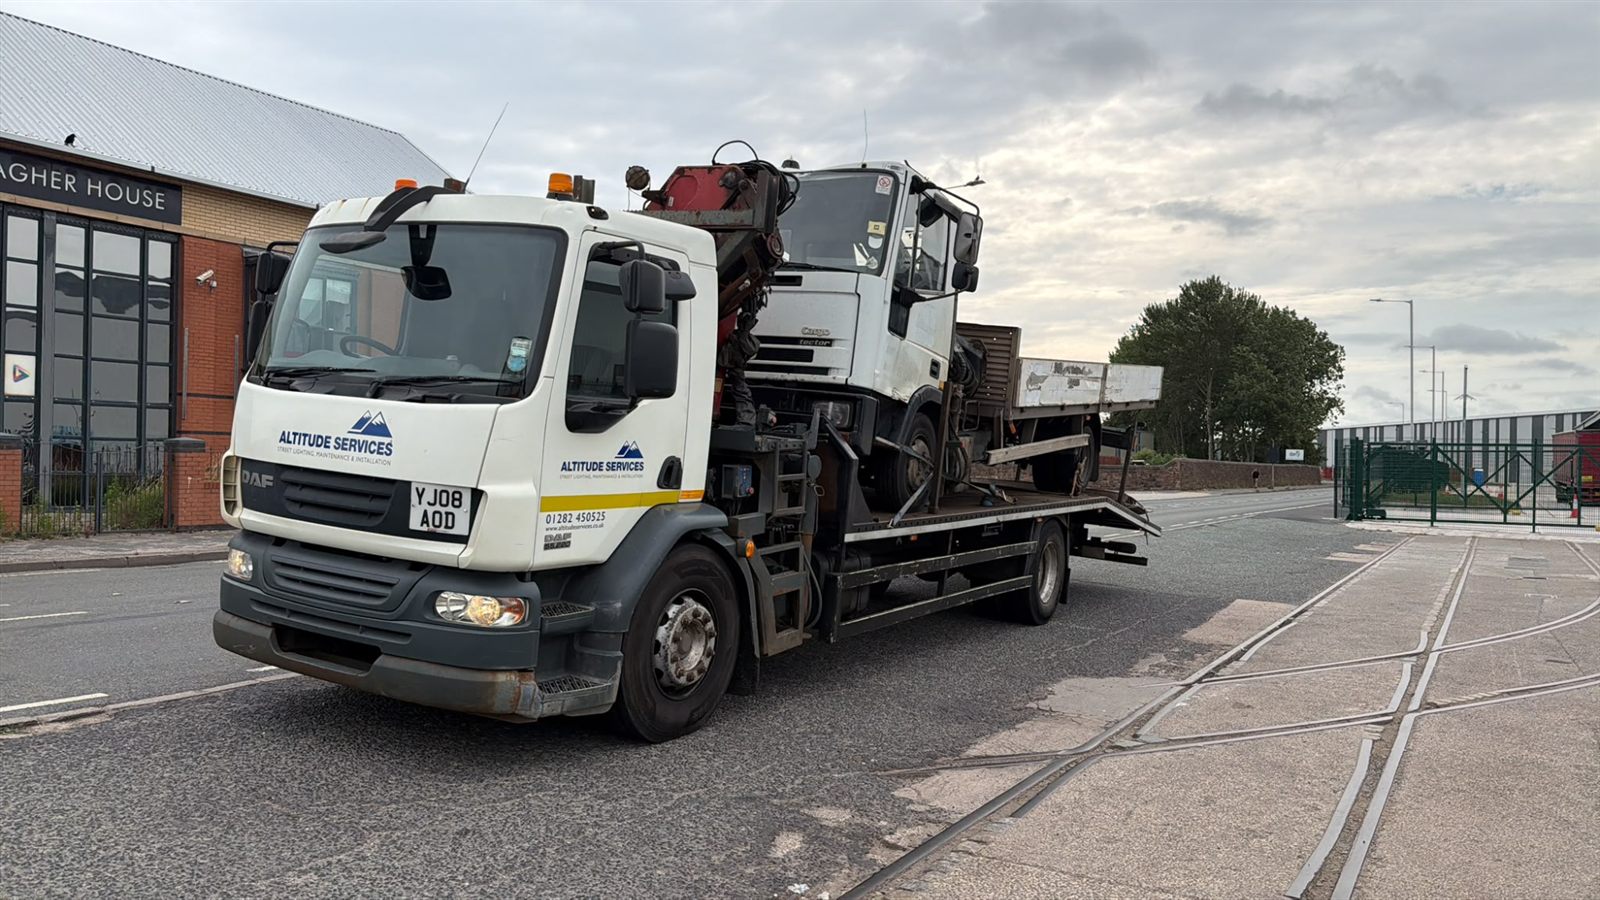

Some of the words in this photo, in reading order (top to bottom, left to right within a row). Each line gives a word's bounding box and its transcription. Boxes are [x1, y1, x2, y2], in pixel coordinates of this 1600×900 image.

[87, 178, 165, 210] HOUSE
[801, 326, 831, 336] Cargo
[799, 338, 831, 346] tector
[279, 430, 332, 449] ALTITUDE
[333, 436, 393, 457] SERVICES
[315, 451, 350, 462] MAINTENANCE
[355, 456, 392, 466] INSTALLATION
[561, 461, 604, 472] ALTITUDE
[605, 461, 645, 471] SERVICES
[242, 469, 274, 488] DAF
[415, 486, 463, 509] YJ08
[420, 509, 455, 530] AOD
[545, 513, 573, 525] 01282
[575, 511, 606, 523] 450525
[544, 532, 572, 543] DAF
